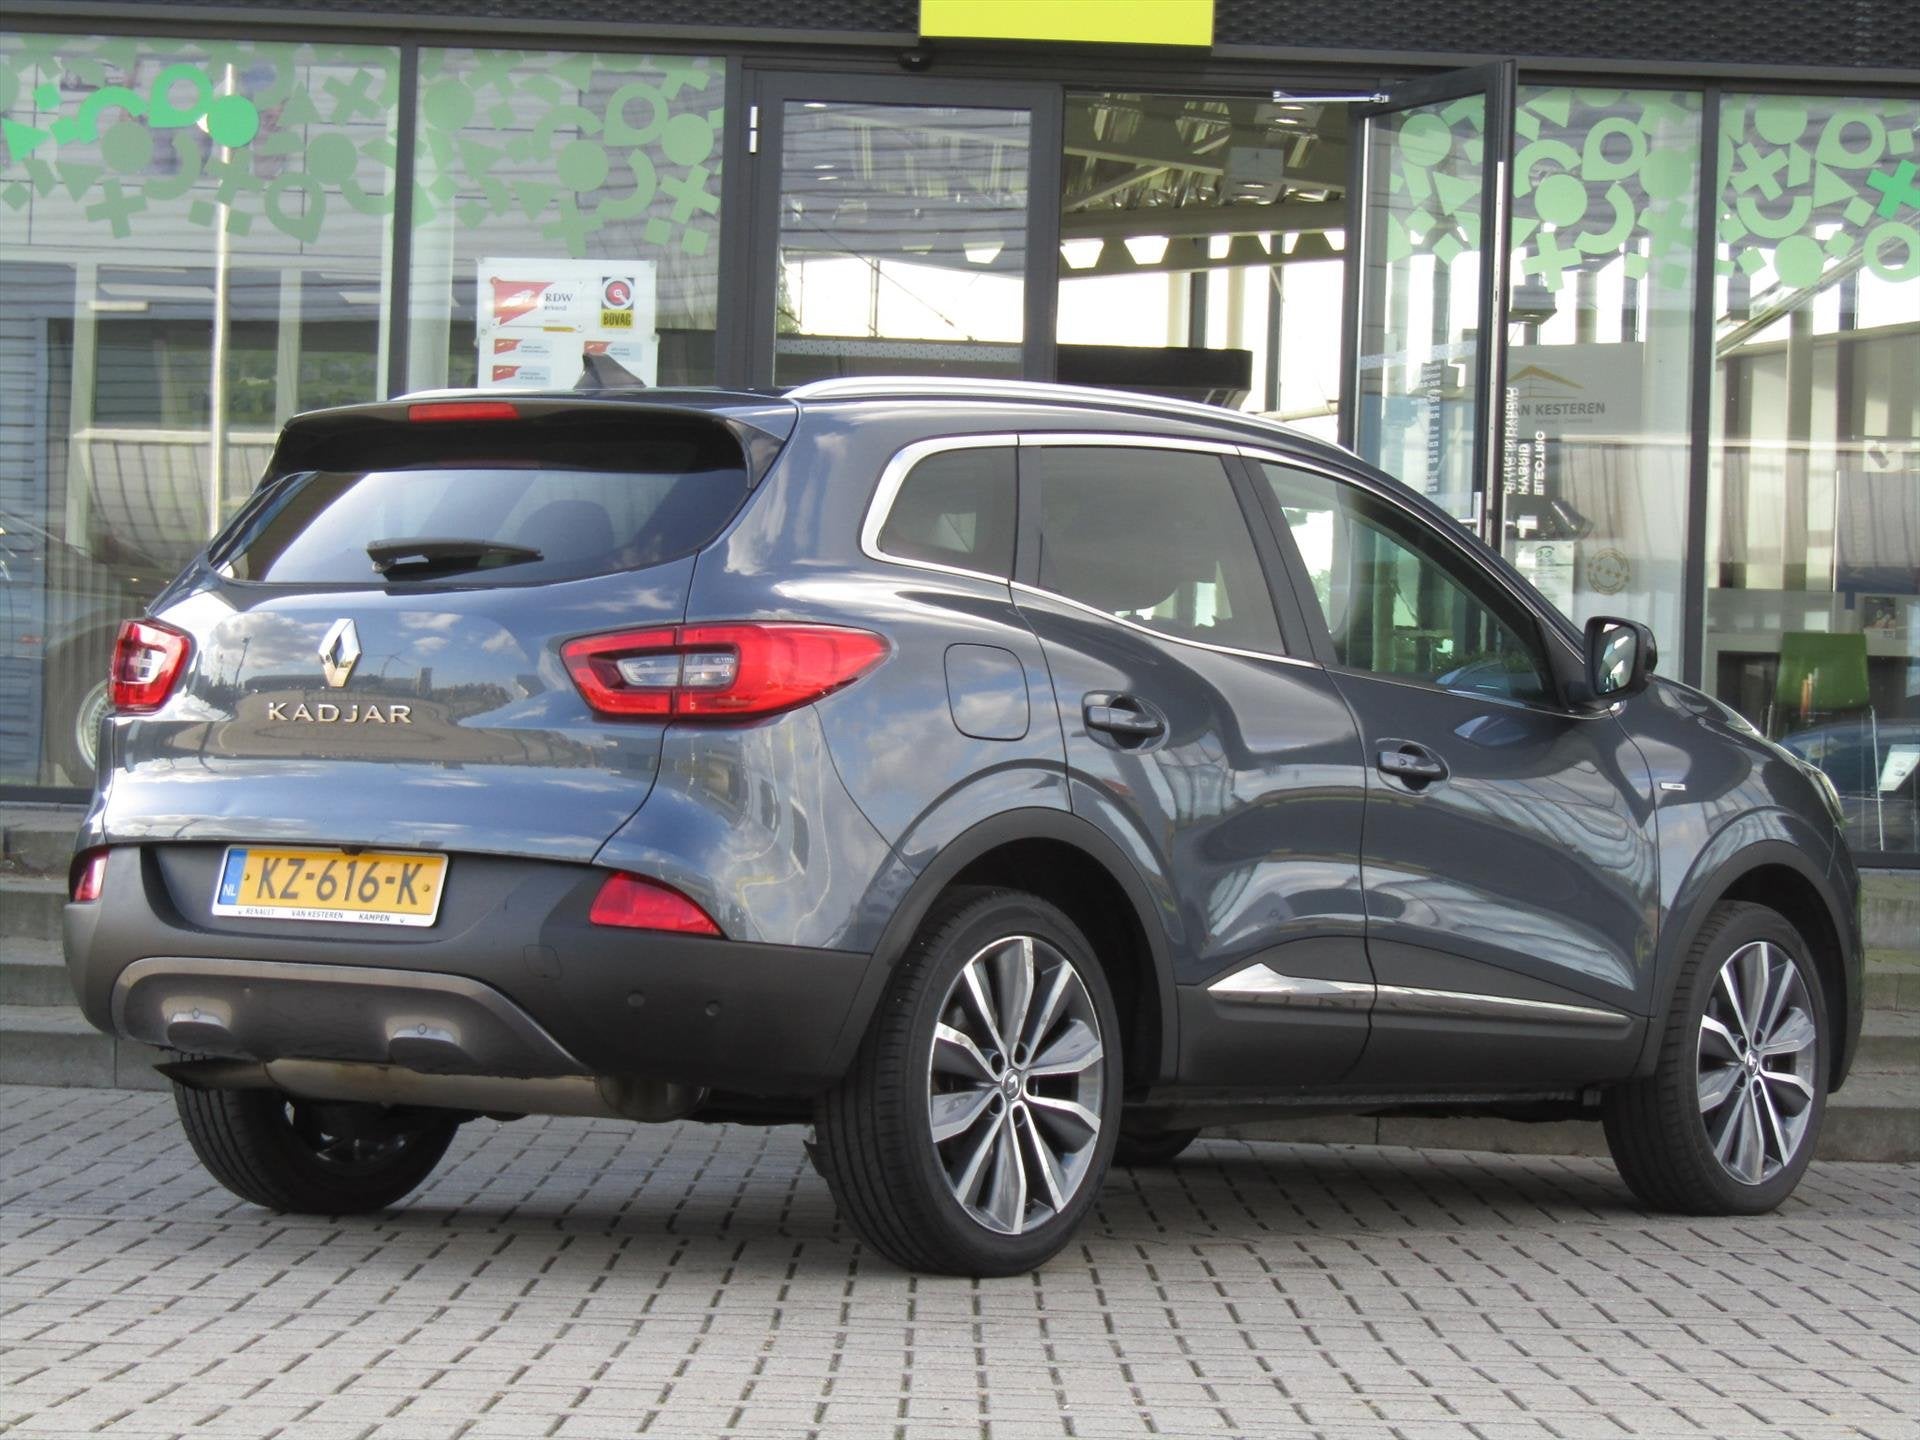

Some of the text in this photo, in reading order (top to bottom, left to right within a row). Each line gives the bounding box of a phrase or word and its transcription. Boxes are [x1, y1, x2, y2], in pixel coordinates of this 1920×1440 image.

[544, 293, 573, 302] RDW
[603, 312, 632, 327] BOVAG
[1535, 402, 1606, 416] KESTEREN
[268, 702, 413, 724] KADJAR
[256, 857, 423, 905] KZ-616-K
[222, 883, 237, 897] NL
[245, 908, 391, 923] RENAULT VAN KESTEREN KAMPEN
